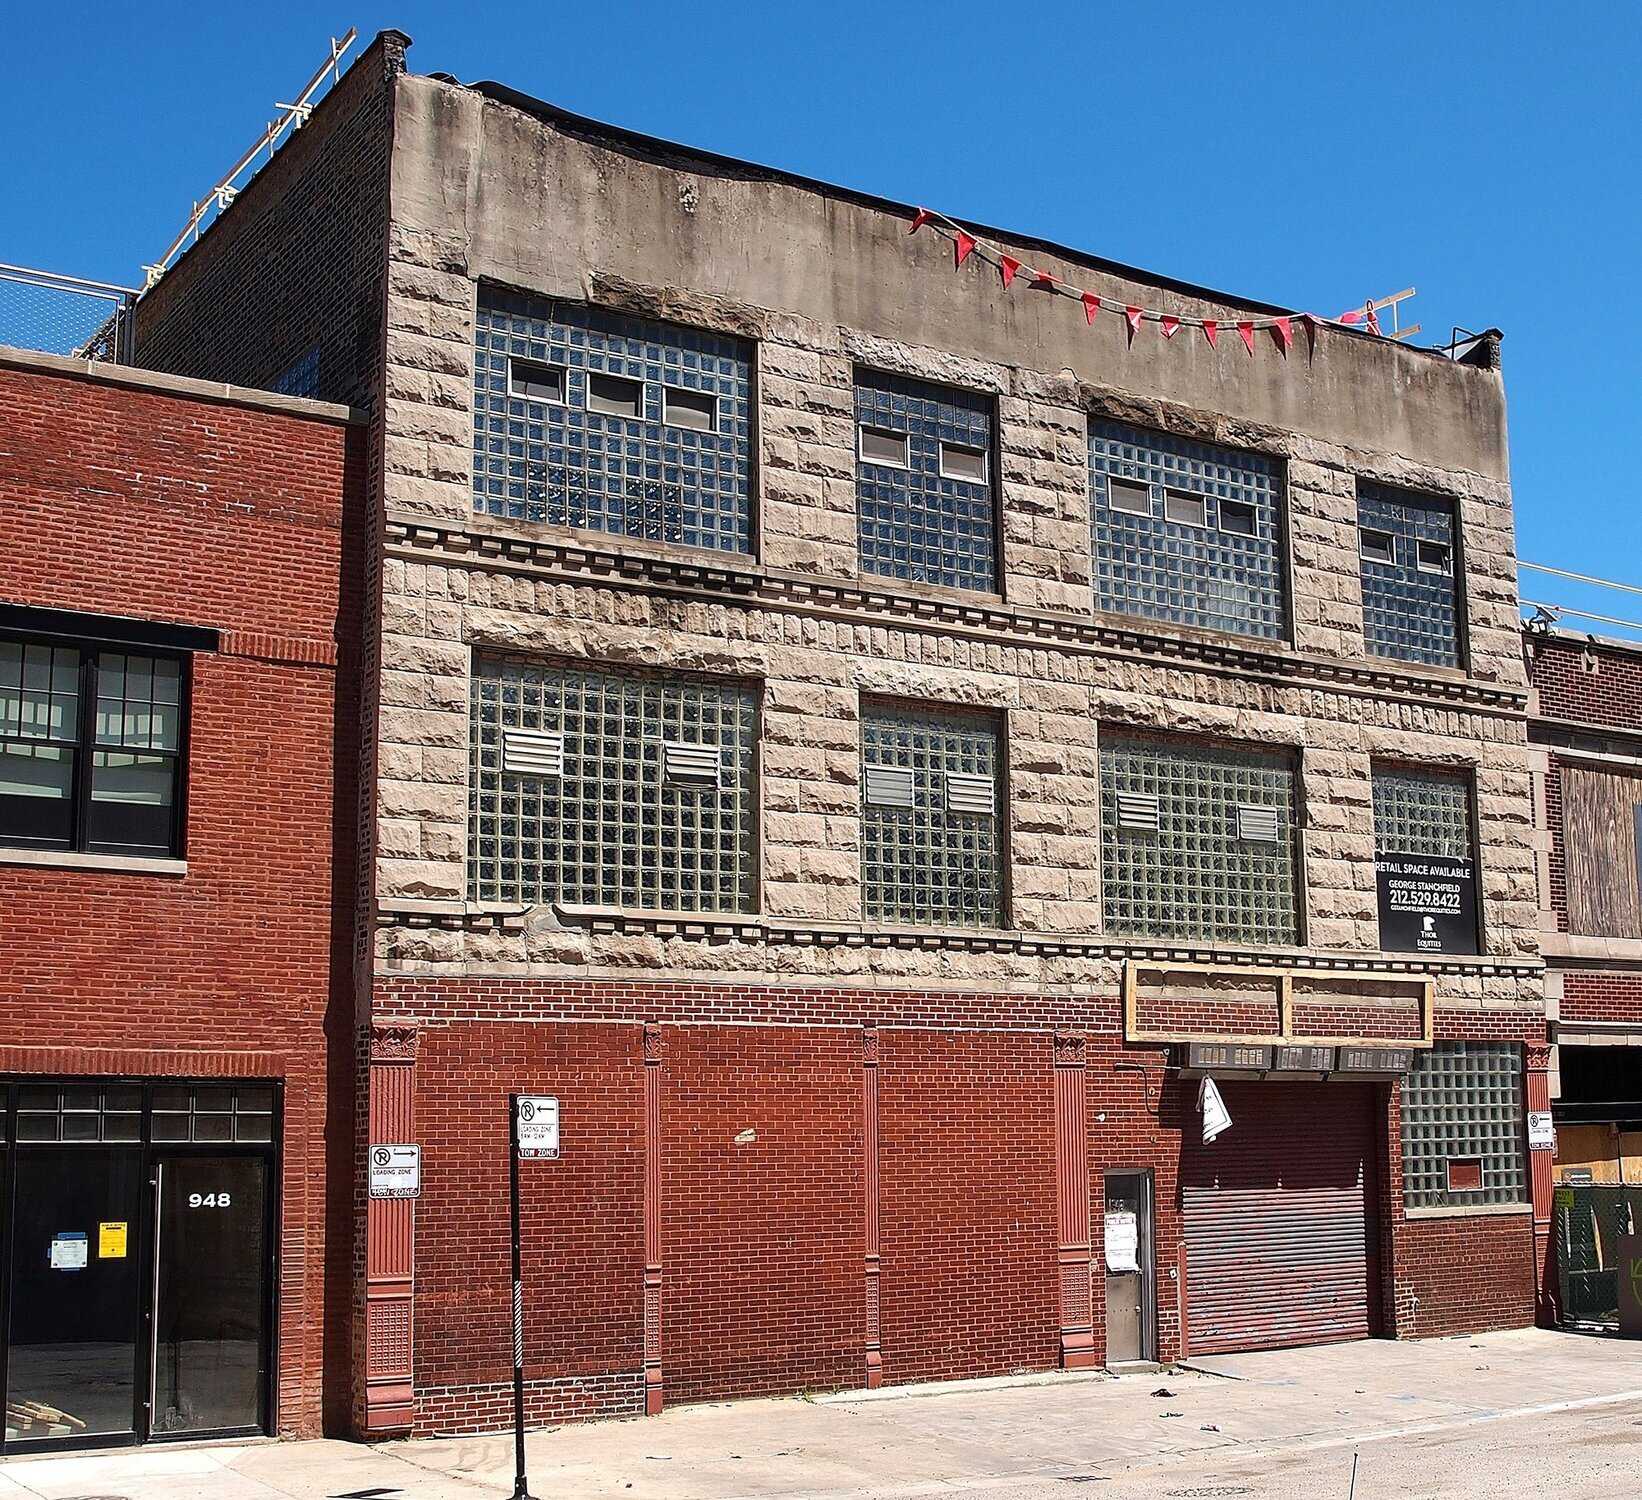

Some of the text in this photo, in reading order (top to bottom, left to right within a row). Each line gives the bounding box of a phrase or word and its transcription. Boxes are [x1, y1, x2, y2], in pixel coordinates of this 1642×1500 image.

[1376, 862, 1470, 878] RETAIL SPACE AVAILABLE
[1389, 880, 1460, 892] GEORGE STANCHFIELD
[1390, 890, 1460, 907] 212.529.8422
[521, 1149, 555, 1157] TOW ZONE
[189, 1193, 230, 1207] 948
